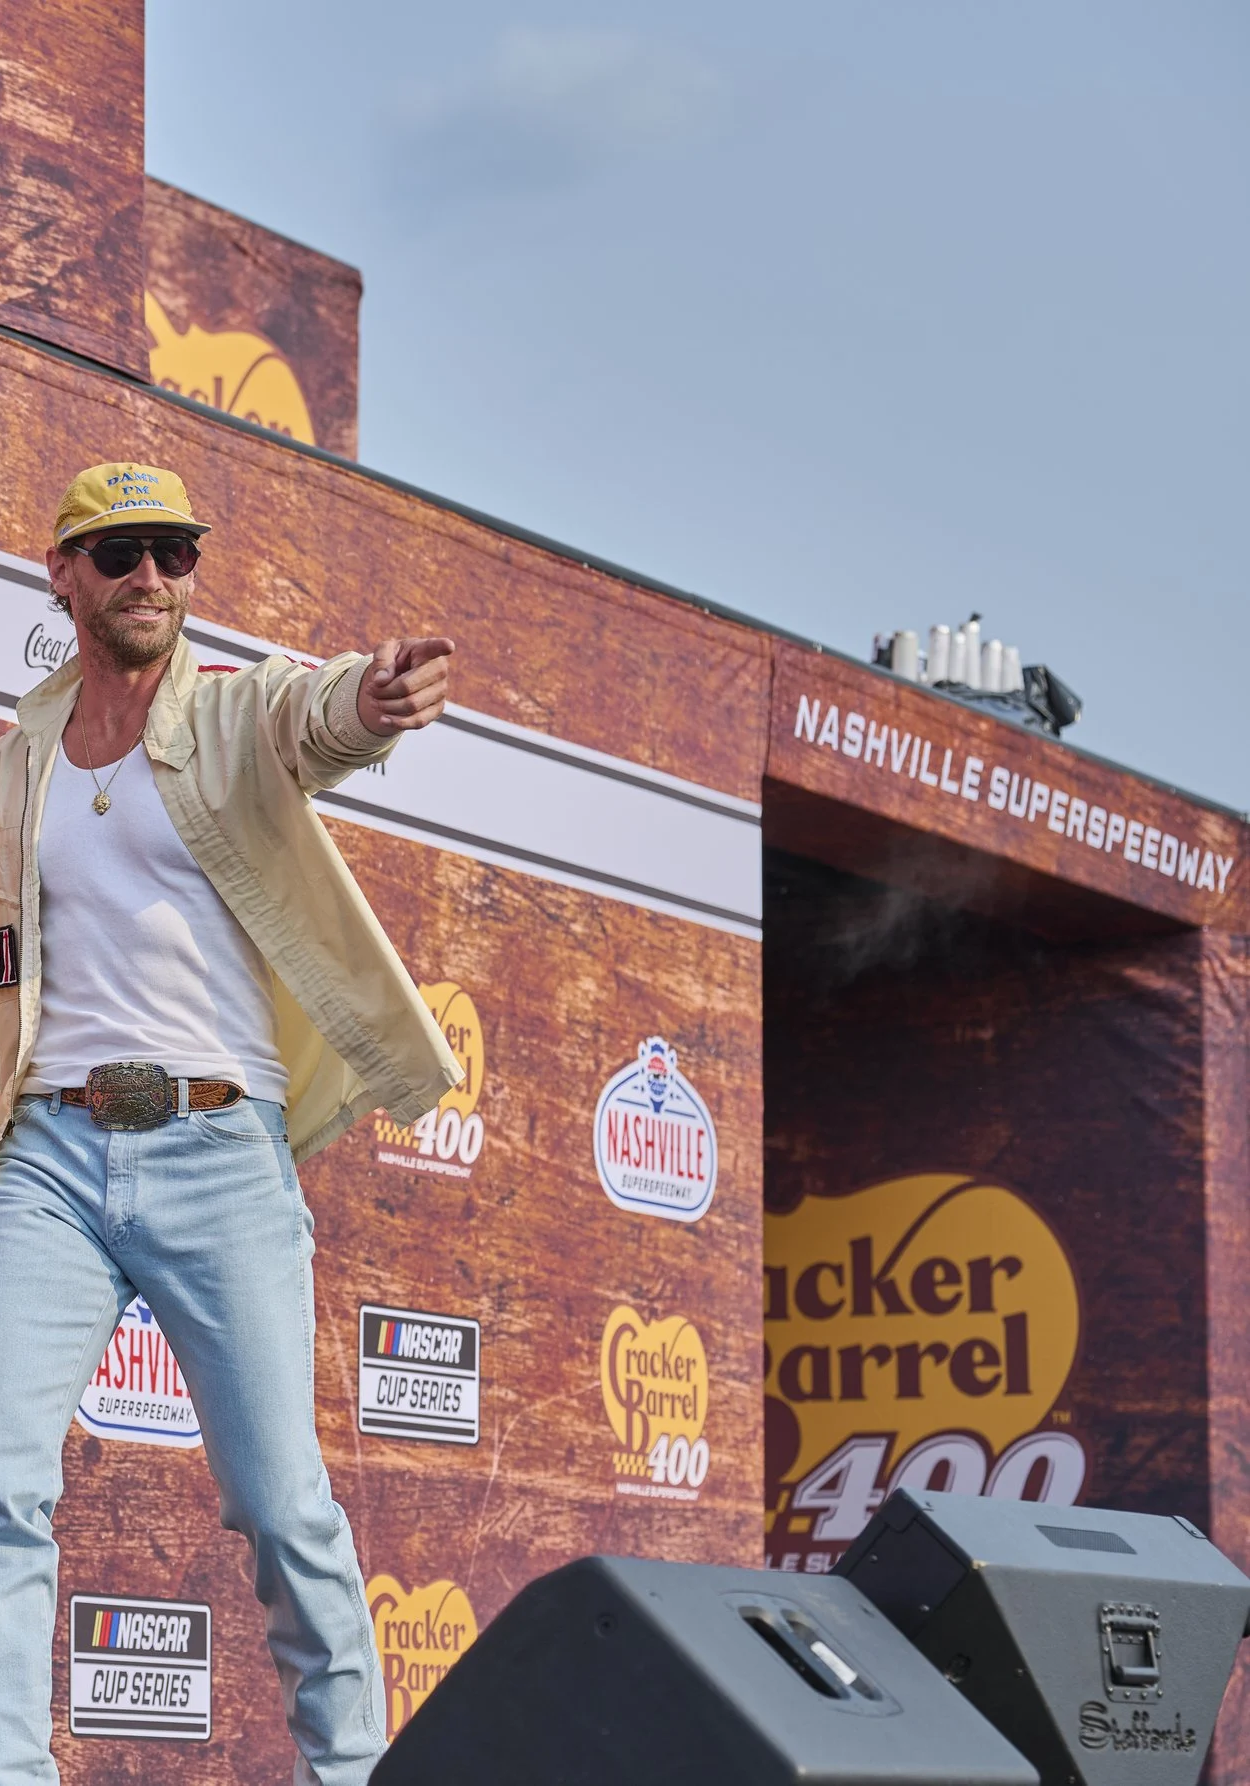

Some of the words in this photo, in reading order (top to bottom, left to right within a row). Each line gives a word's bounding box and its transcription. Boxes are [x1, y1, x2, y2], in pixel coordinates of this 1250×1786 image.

[24, 623, 78, 673] Coca-
[794, 694, 985, 802] NASHVILLE
[986, 765, 1234, 895] SUPERSPEEDWAY
[414, 1107, 486, 1165] 400
[607, 1108, 705, 1182] NASHVILLE
[763, 1235, 1023, 1322] cker
[89, 1326, 191, 1399] ASHVIL
[398, 1322, 463, 1364] NASCAR
[608, 1322, 698, 1410] Cracker
[98, 1396, 192, 1424] SUPERSPEEDWAY
[376, 1375, 408, 1407] CUP
[409, 1379, 463, 1413] SERIES
[625, 1378, 698, 1454] Barrel
[649, 1433, 710, 1488] 400
[116, 1611, 192, 1653] NASCAR
[91, 1669, 128, 1704] CUP
[130, 1672, 192, 1708] SERIES
